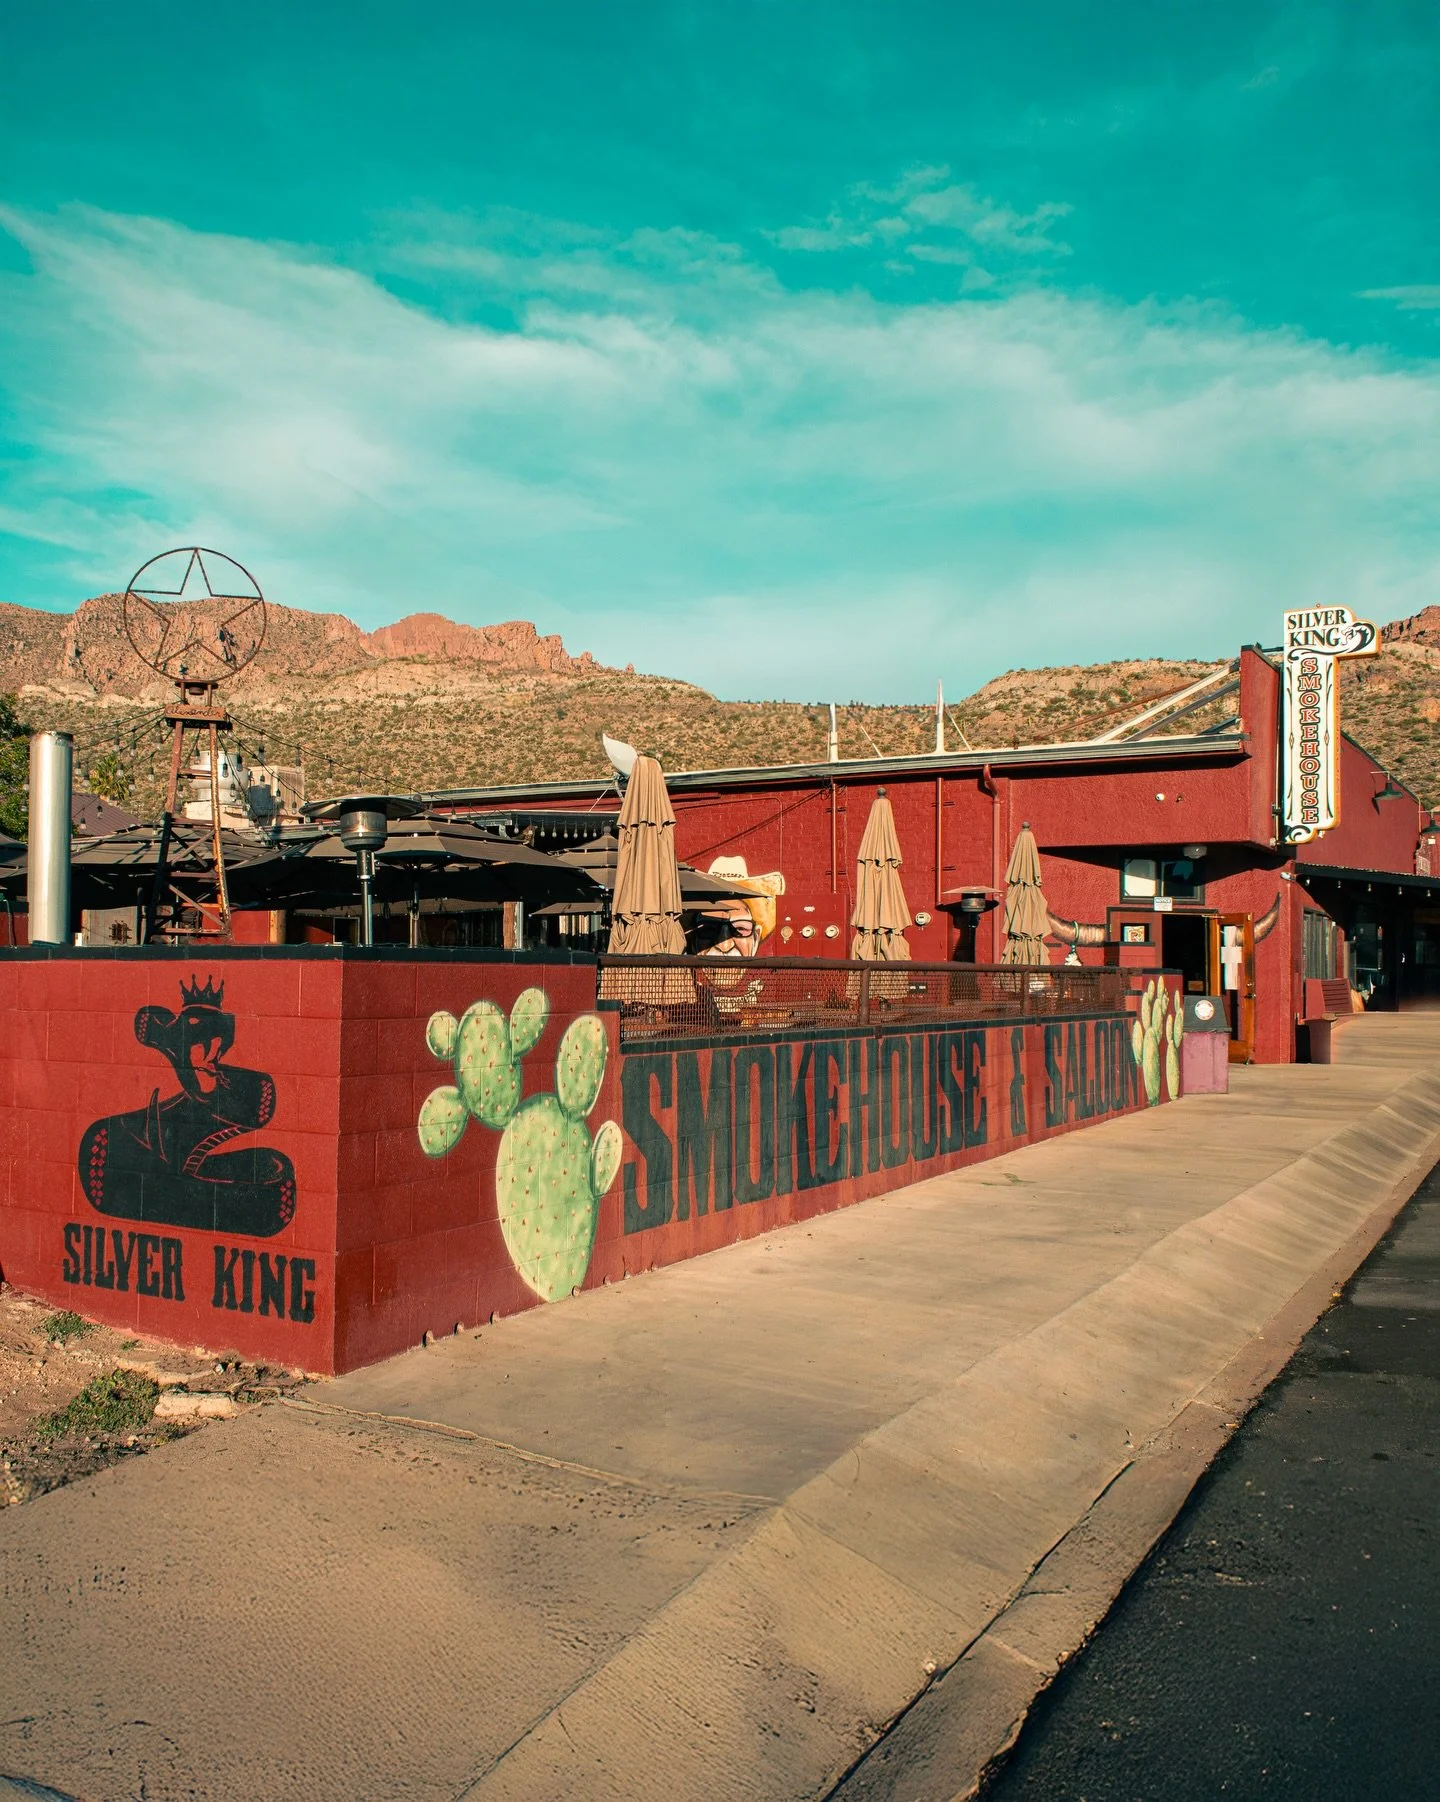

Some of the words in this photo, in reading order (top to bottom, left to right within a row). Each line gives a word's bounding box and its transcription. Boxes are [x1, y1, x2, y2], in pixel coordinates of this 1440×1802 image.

[1288, 609, 1347, 630] SILVER
[1289, 627, 1341, 647] KING
[1299, 657, 1321, 825] SMOKEHOUSE
[620, 1030, 988, 1235] SMOKEHOUSE
[1009, 1027, 1027, 1137] &
[1044, 1019, 1139, 1128] SALOON
[62, 1222, 185, 1302] SILVER
[211, 1245, 316, 1324] KING
